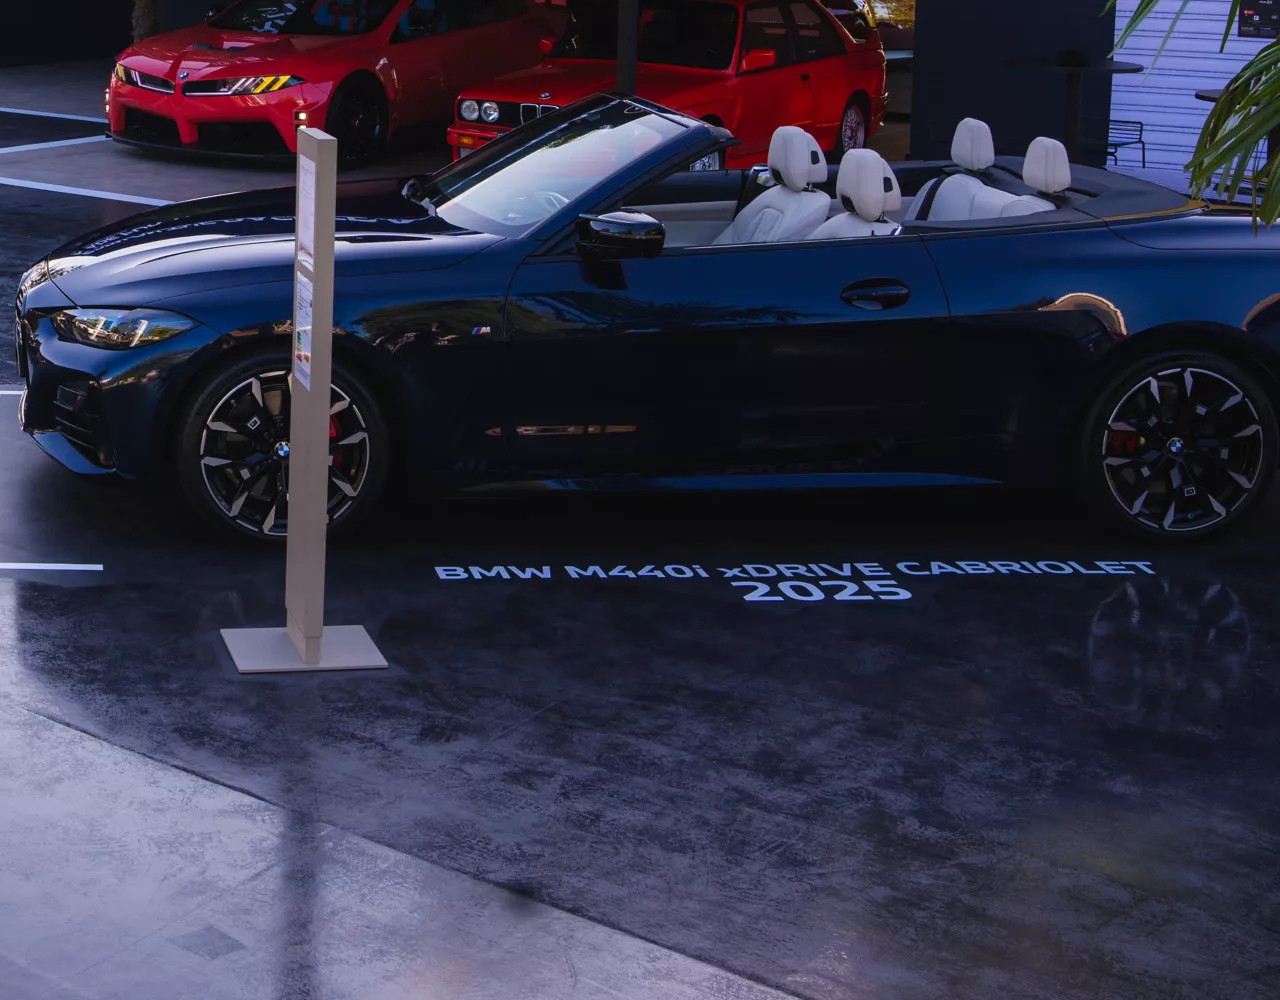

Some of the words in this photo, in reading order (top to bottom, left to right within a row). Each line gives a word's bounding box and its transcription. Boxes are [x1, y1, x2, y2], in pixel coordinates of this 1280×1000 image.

[434, 565, 552, 580] BMW
[563, 564, 710, 579] M440i
[716, 562, 892, 578] xDRIVE
[896, 560, 1157, 575] CABRIOLET
[730, 579, 914, 602] 2025
